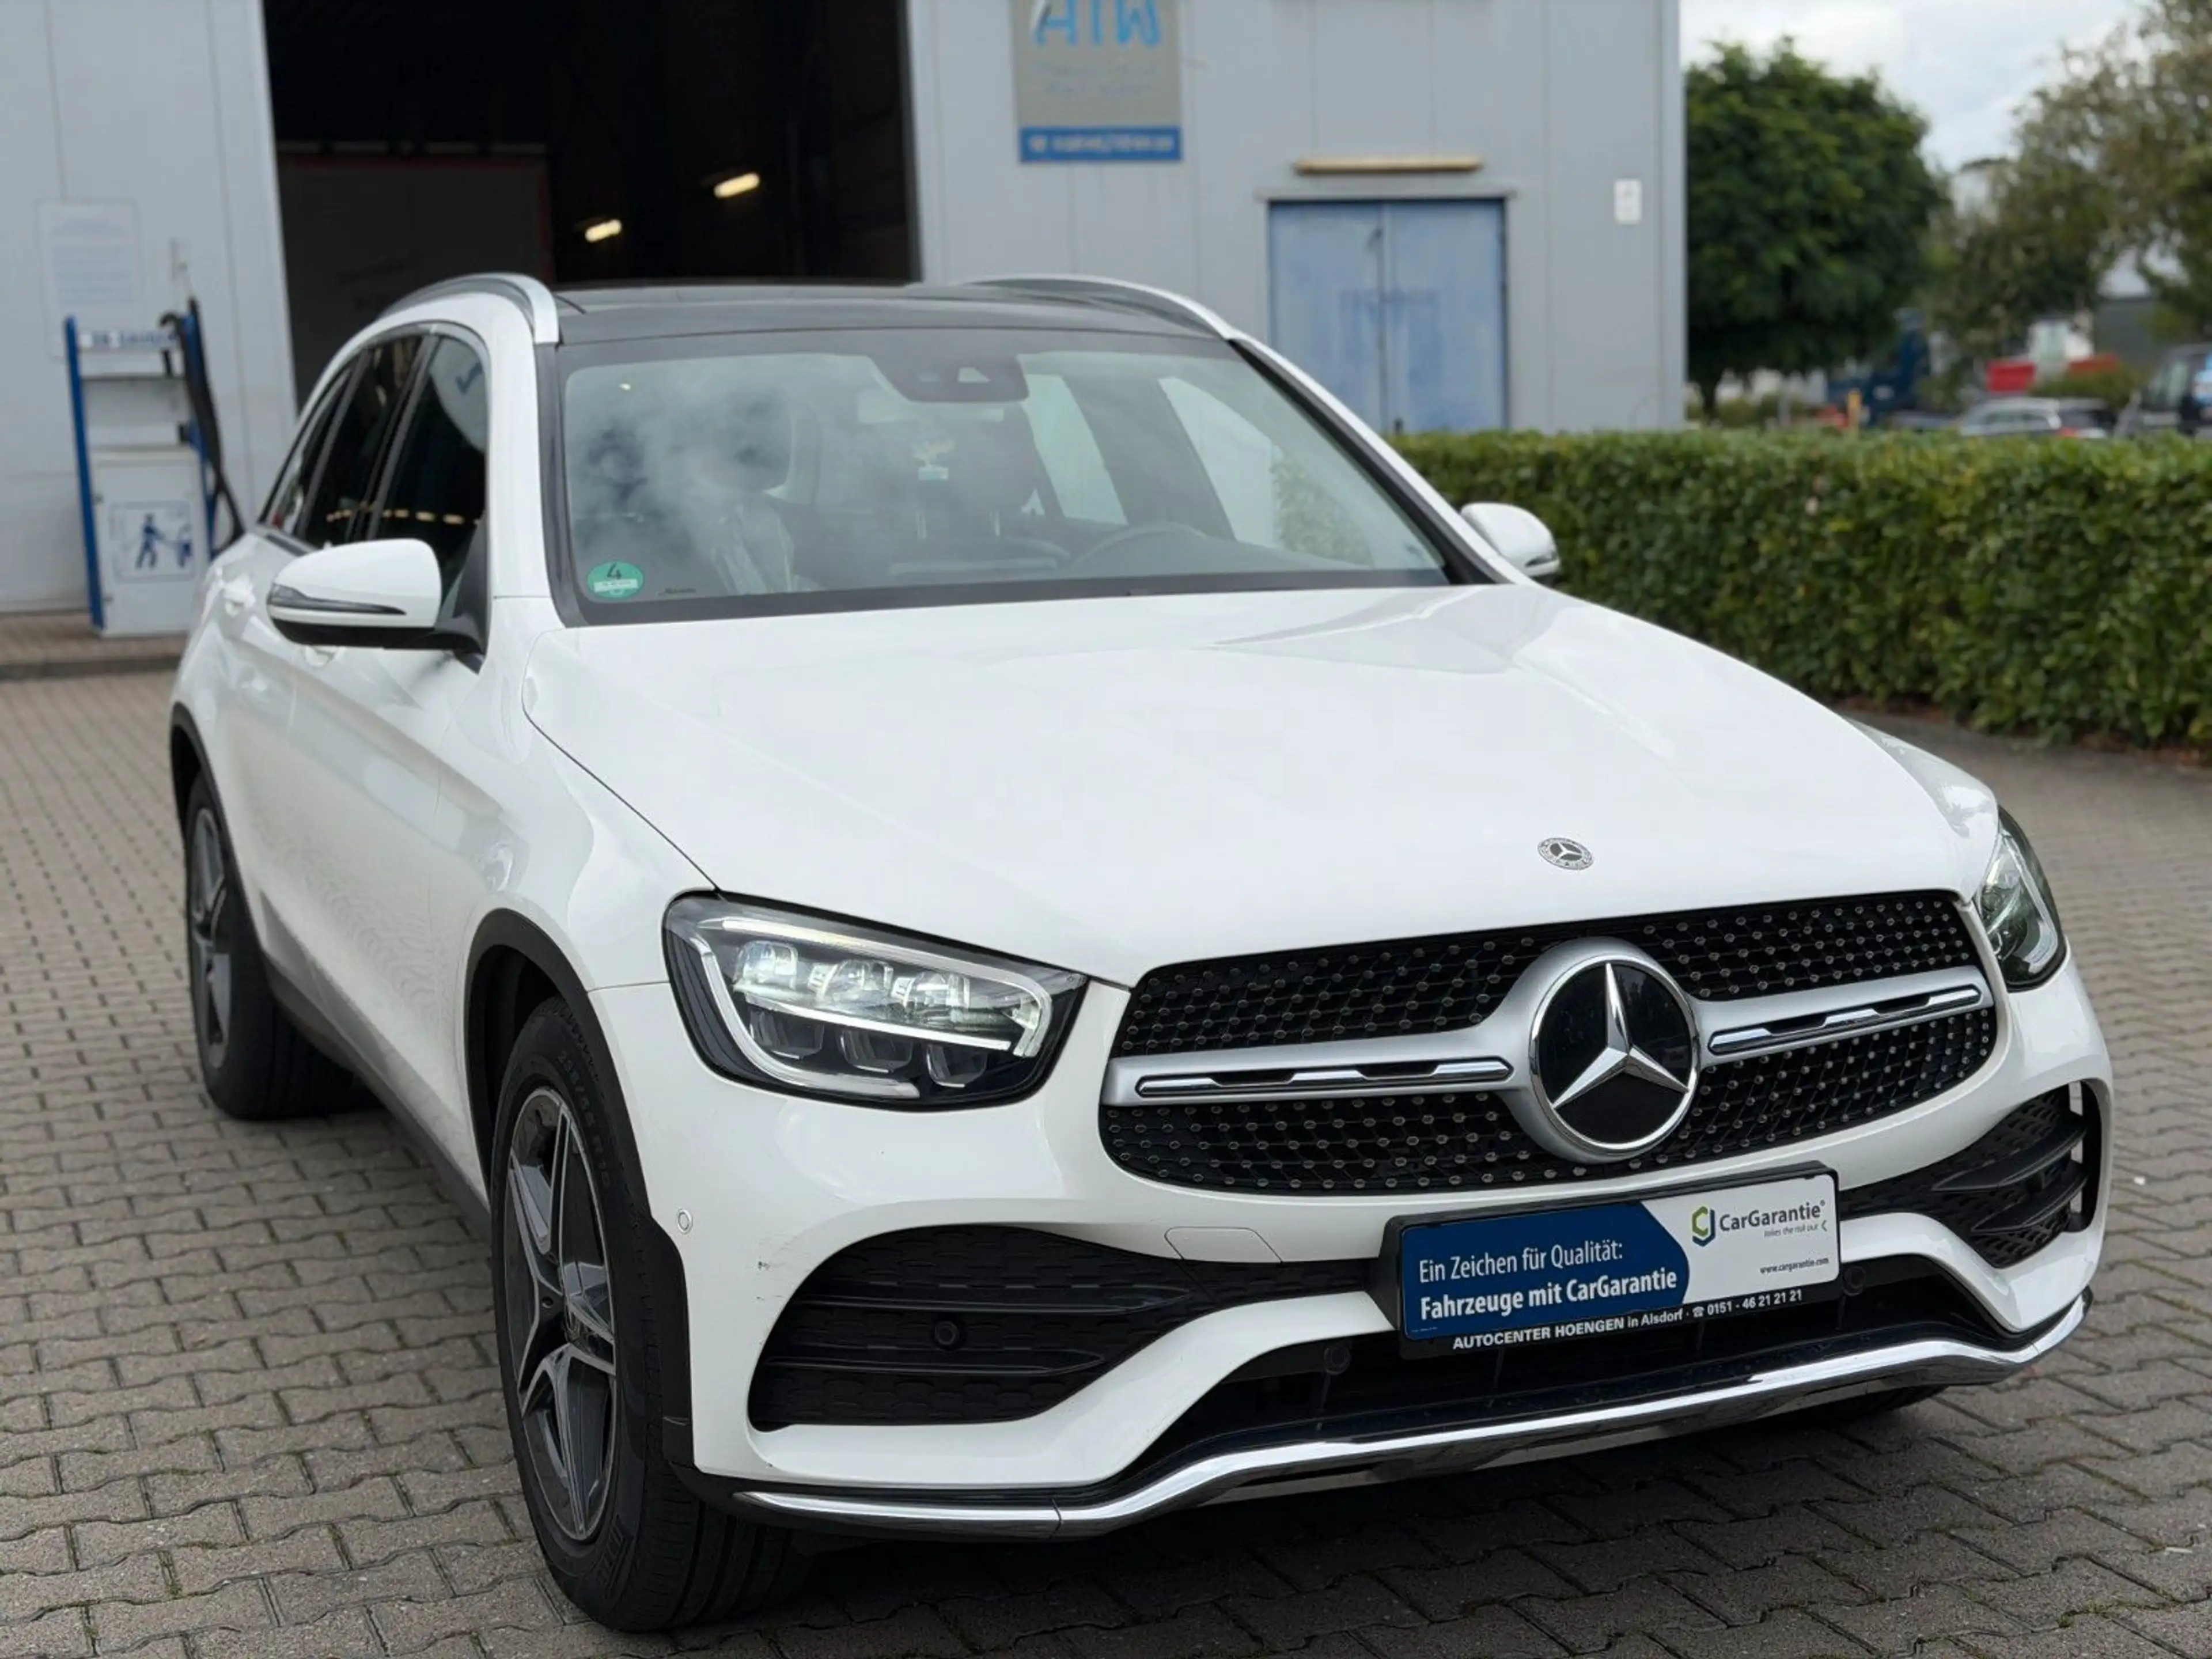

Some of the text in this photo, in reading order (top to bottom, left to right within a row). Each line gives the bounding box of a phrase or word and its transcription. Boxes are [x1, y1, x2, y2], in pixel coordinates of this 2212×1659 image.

[607, 562, 622, 579] 4
[1419, 1239, 1623, 1283] Ein Zeichen für Qualität:
[1421, 1267, 1677, 1320] Fahrzeuge mit CarGarantie
[1452, 1326, 1551, 1350] AUTOCENTER
[1555, 1317, 1624, 1338] HOENGEN
[1627, 1316, 1638, 1328] in
[1641, 1308, 1683, 1326] Alsdorf
[1707, 1300, 1733, 1316] 0151
[1742, 1297, 1756, 1309] 46
[1758, 1293, 1771, 1307] 21
[1774, 1292, 1786, 1305] 21
[1790, 1289, 1802, 1302] 21
